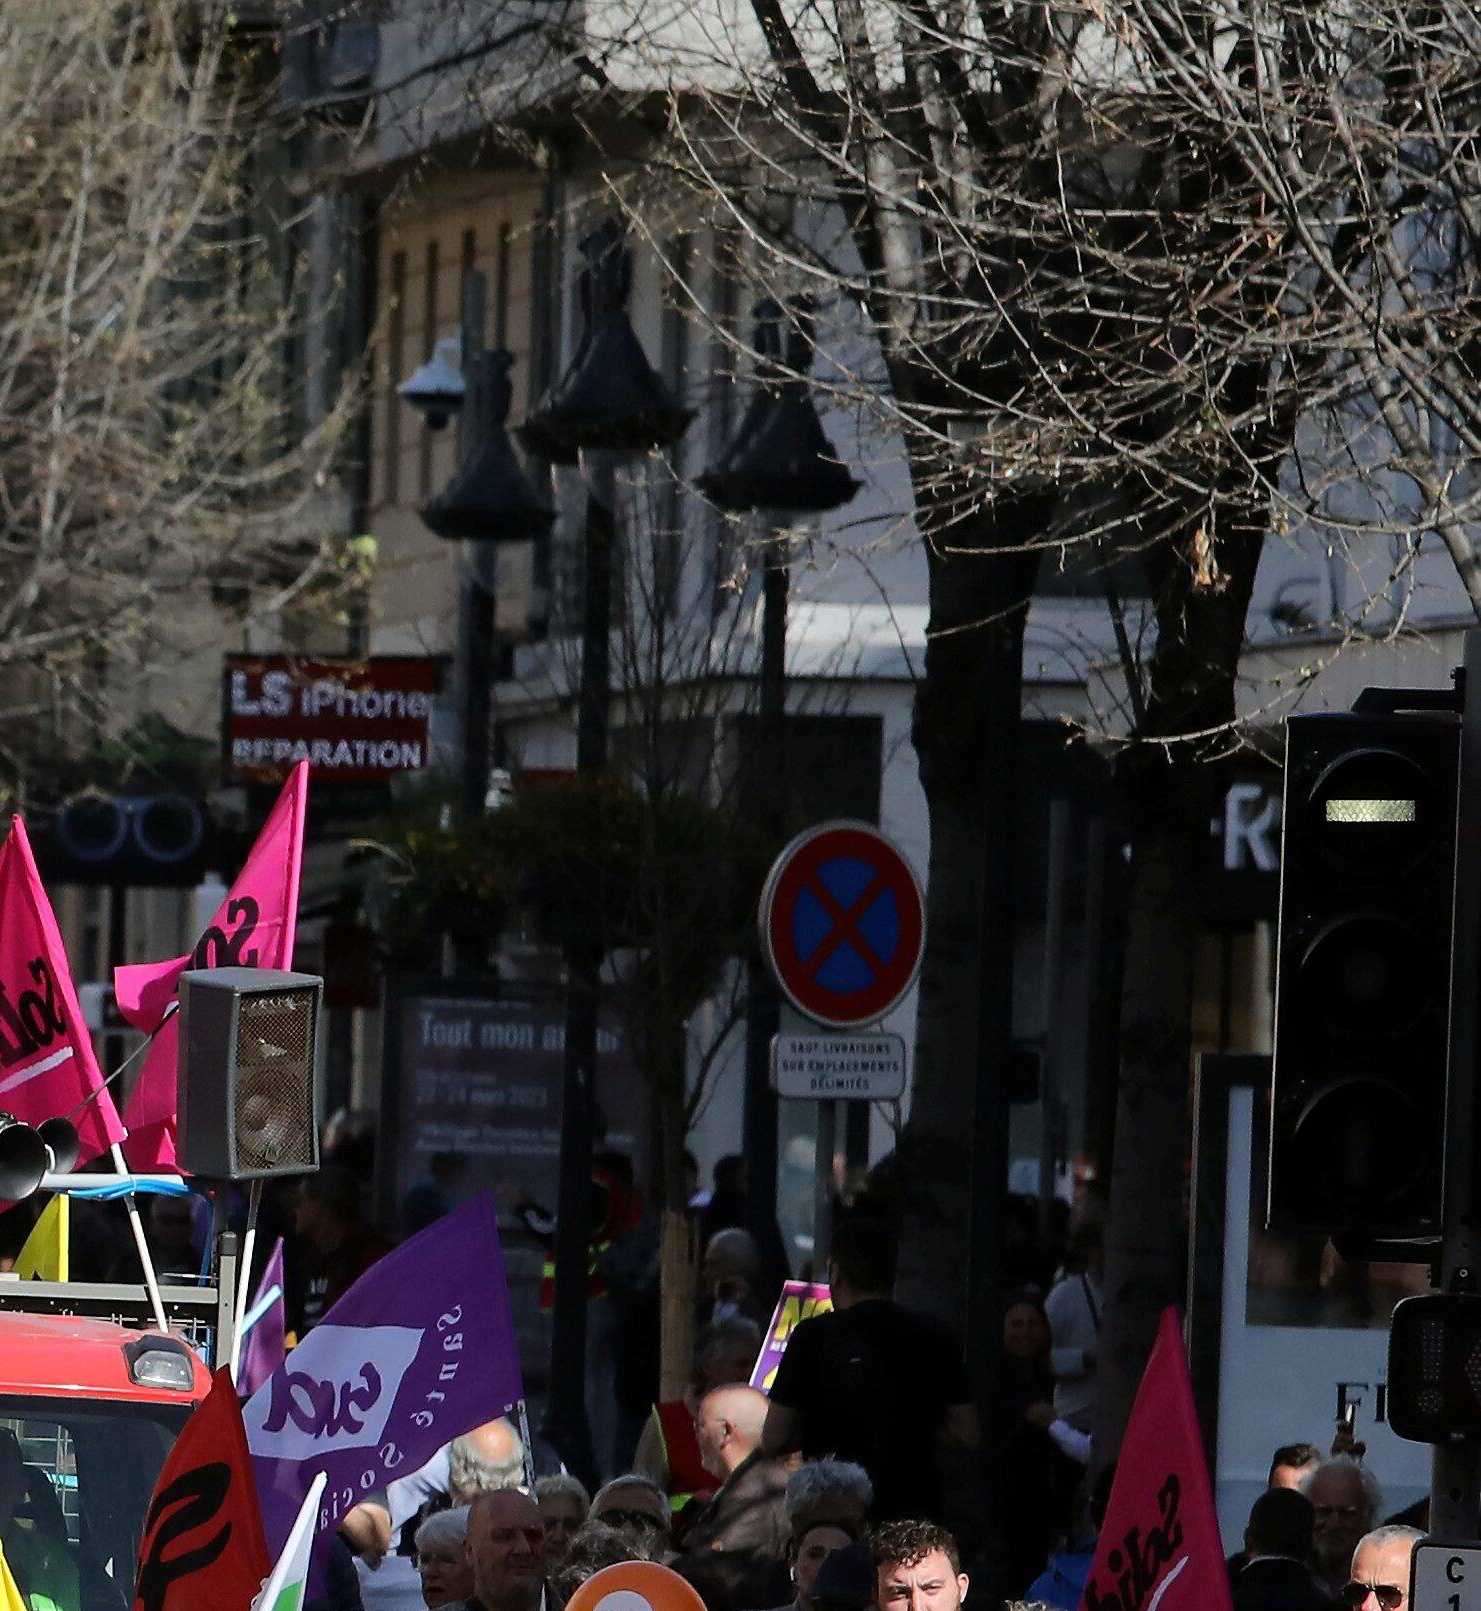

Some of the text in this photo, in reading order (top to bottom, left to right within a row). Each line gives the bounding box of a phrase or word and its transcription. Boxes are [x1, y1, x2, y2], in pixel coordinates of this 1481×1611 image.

[231, 669, 293, 716] LS
[420, 1012, 473, 1048] Tout
[480, 1022, 534, 1051] mon
[790, 1042, 819, 1054] SAUF
[782, 1059, 804, 1072] SUR
